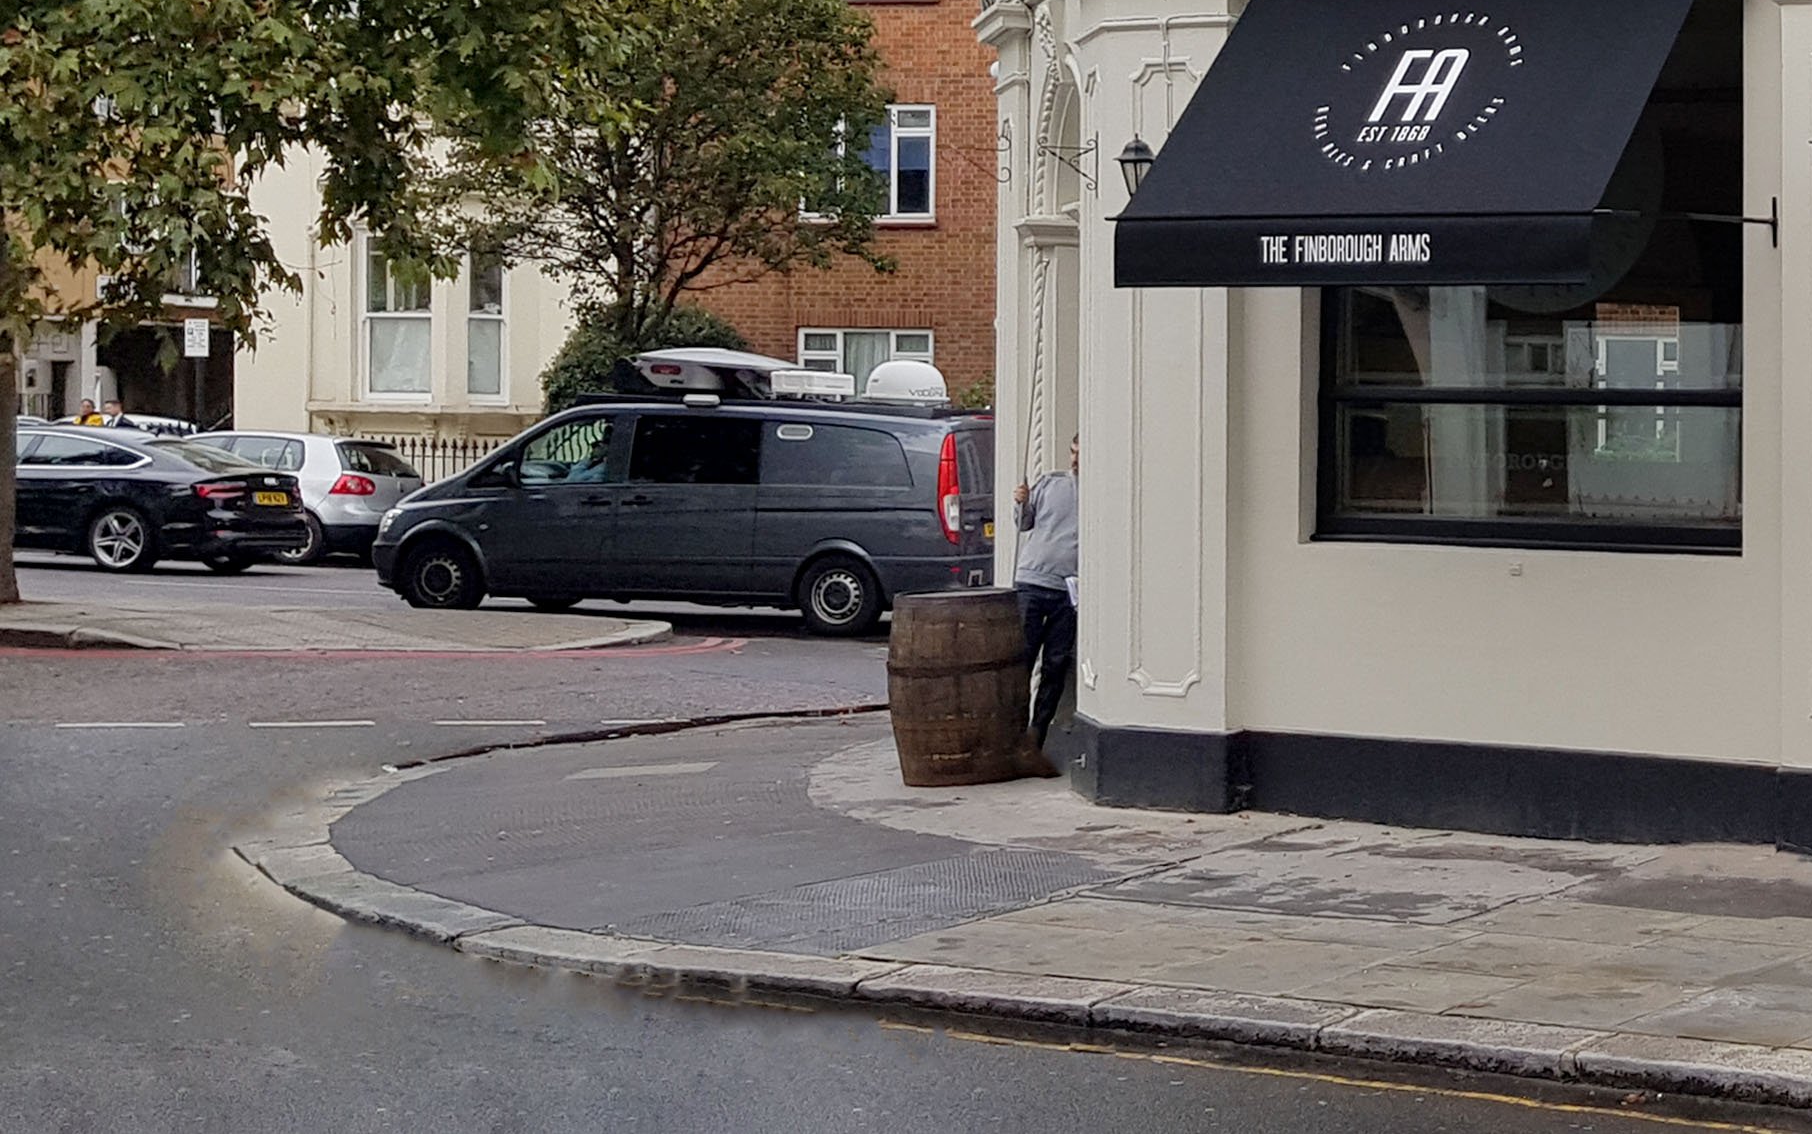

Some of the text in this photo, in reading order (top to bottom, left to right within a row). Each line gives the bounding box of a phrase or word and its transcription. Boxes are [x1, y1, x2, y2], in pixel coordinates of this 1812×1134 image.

[1341, 13, 1523, 71] FINBOROUGH ARMS
[1367, 48, 1470, 122] FA
[1356, 125, 1431, 142] EST 1868
[1384, 143, 1444, 169] CRAFT
[1261, 233, 1431, 263] THE FINBOROUGH ARMS
